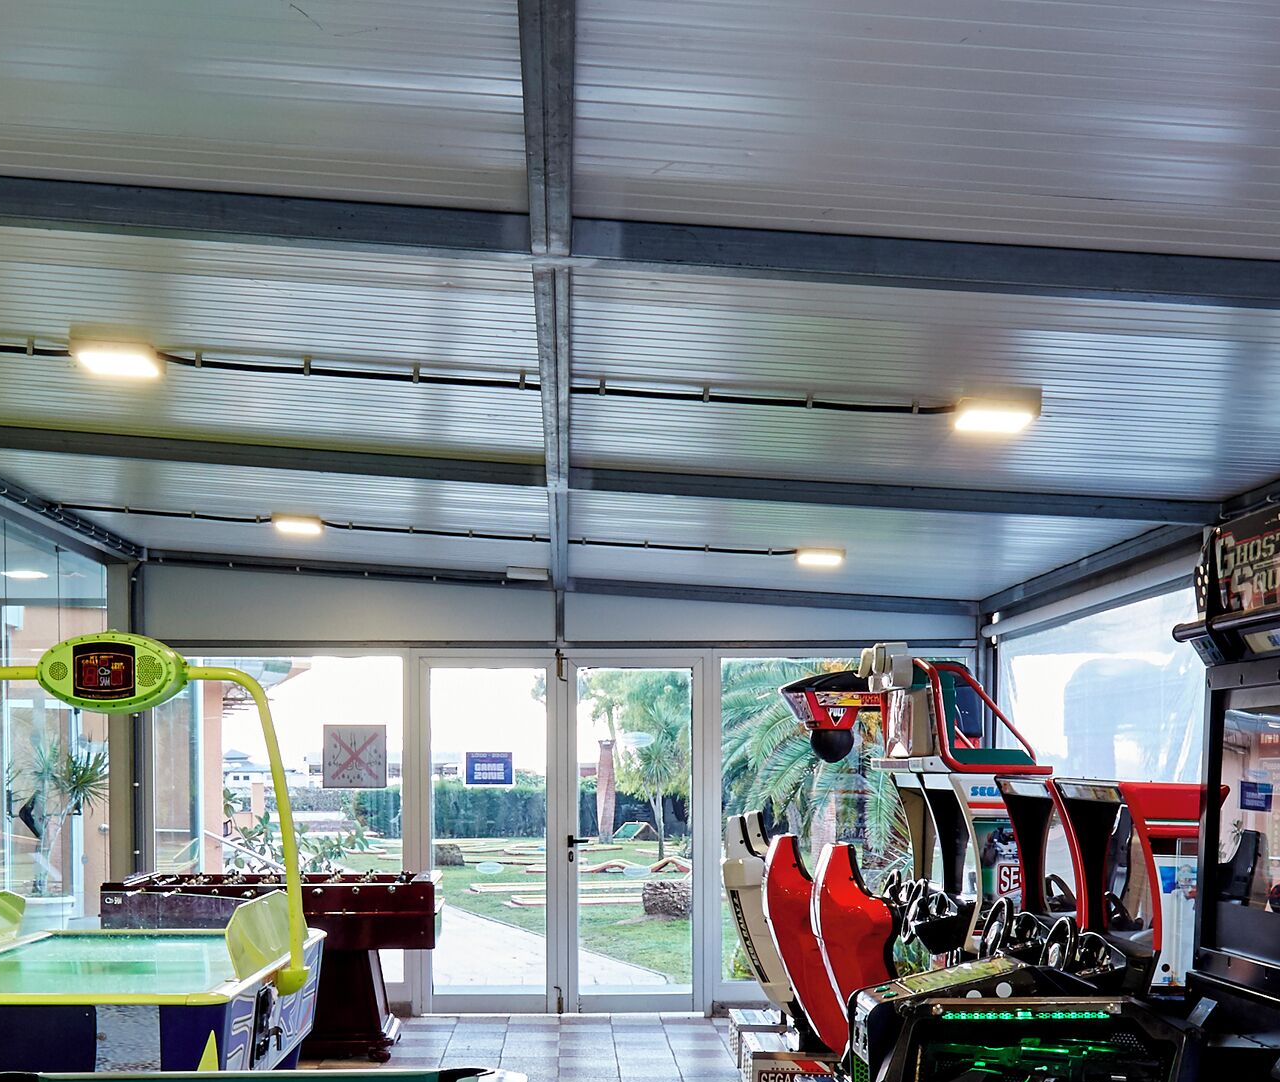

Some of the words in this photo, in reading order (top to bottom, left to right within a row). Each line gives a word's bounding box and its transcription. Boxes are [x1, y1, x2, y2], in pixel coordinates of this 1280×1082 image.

[828, 707, 845, 717] PULL
[474, 763, 505, 771] GAME
[473, 771, 505, 780] ZONE
[1000, 866, 1020, 893] SE
